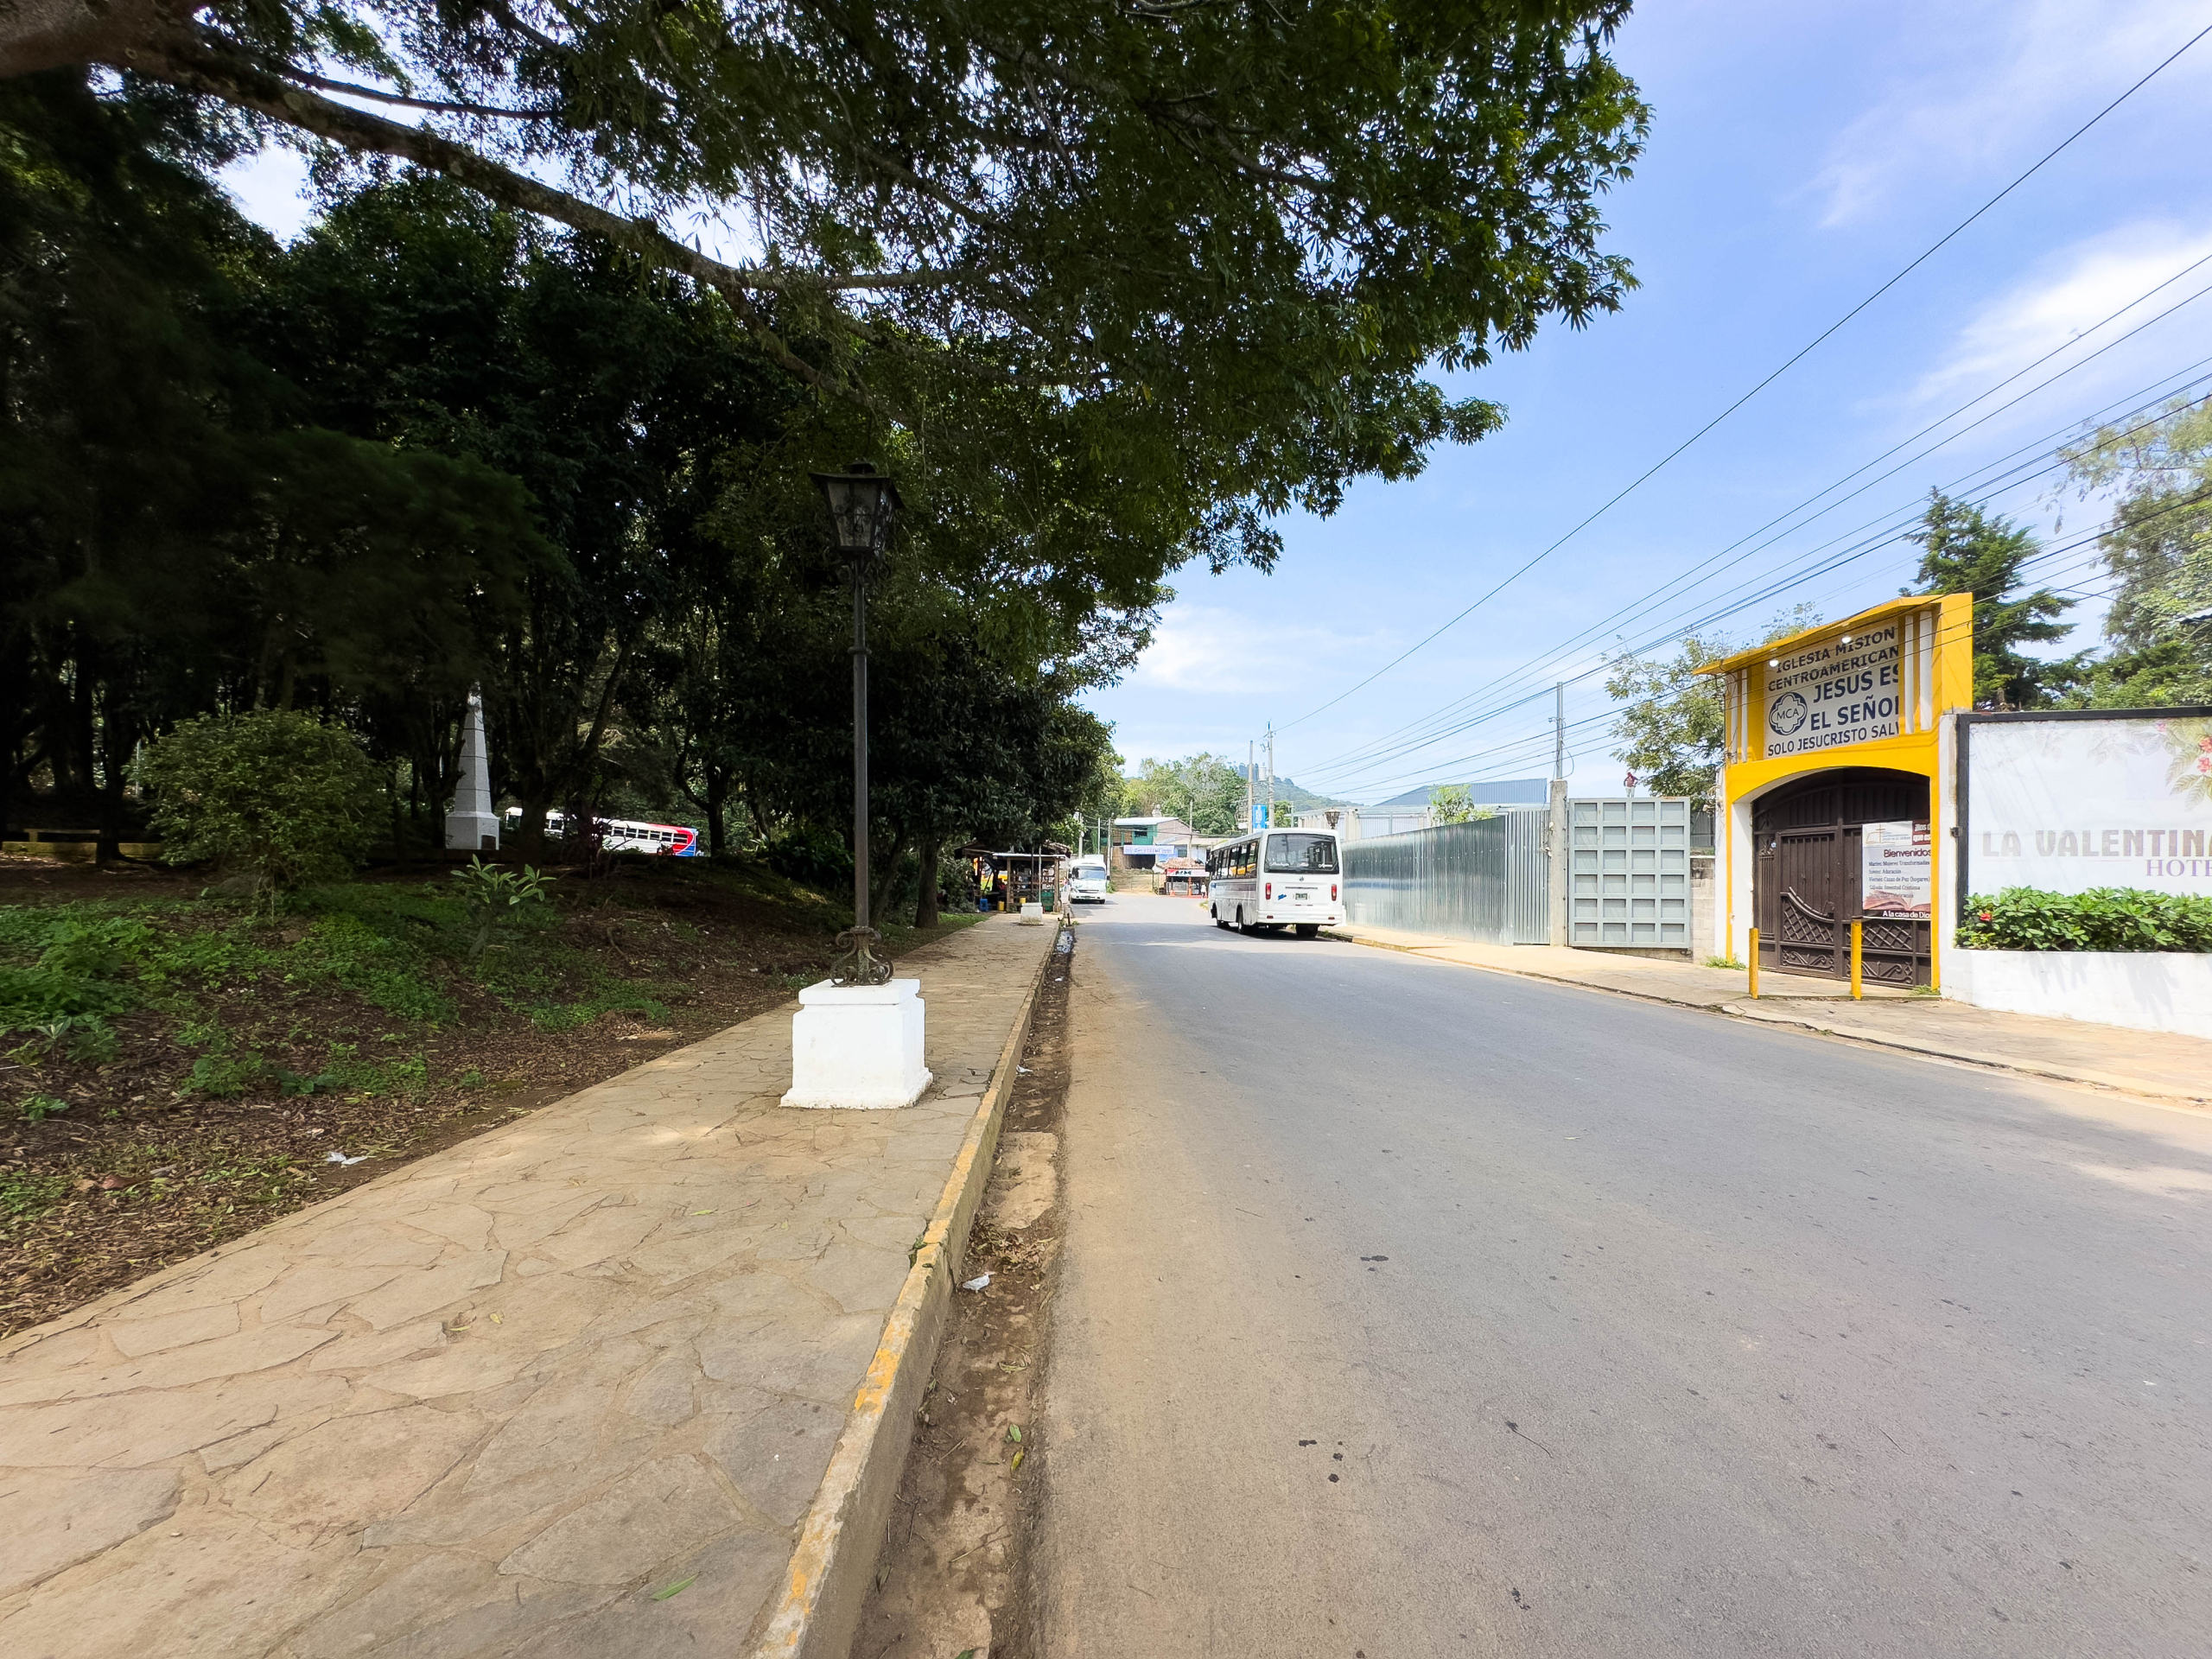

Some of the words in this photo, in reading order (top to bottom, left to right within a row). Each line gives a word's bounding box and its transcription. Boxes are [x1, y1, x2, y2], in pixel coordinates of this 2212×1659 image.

[1777, 648, 1831, 674] IGLESIA
[1835, 626, 1895, 657] MISION
[1813, 670, 1873, 703] JESUS
[1777, 707, 1800, 722] MCA
[1811, 710, 1832, 733] EL
[1768, 740, 1795, 757] SOLO
[1797, 727, 1867, 752] JESUCRISTO
[1982, 830, 2022, 857] LA
[2035, 829, 2212, 857] VALENTIN
